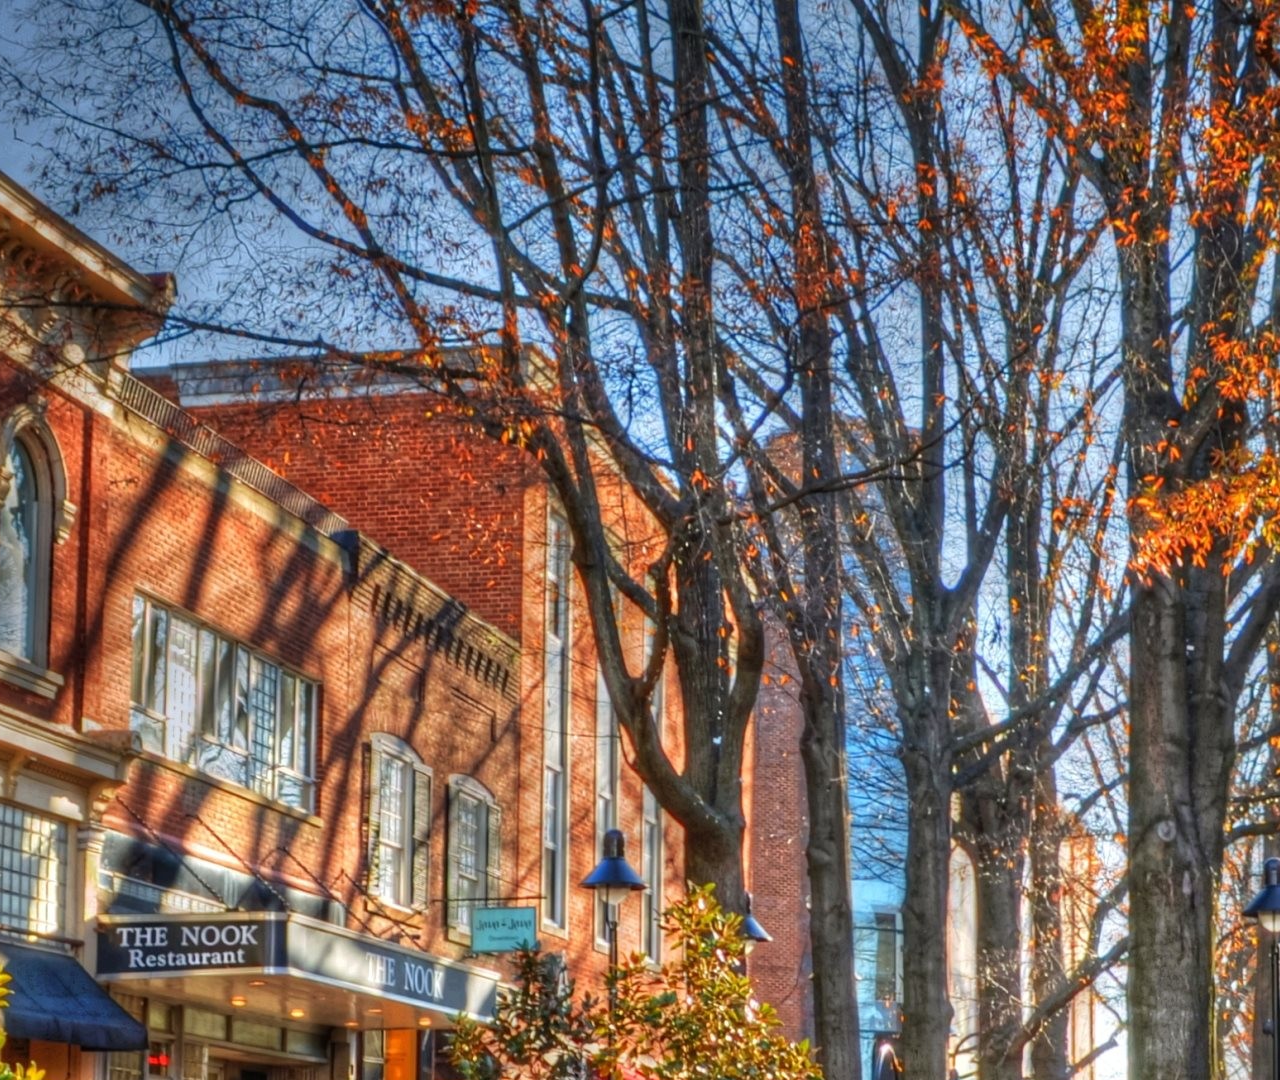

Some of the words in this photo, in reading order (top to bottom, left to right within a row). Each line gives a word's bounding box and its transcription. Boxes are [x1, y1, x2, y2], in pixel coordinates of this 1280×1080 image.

[116, 927, 168, 947] THE
[180, 924, 259, 946] NOOK
[128, 948, 246, 969] Restaurant
[366, 952, 396, 987] THE
[403, 962, 444, 1000] NOOK
